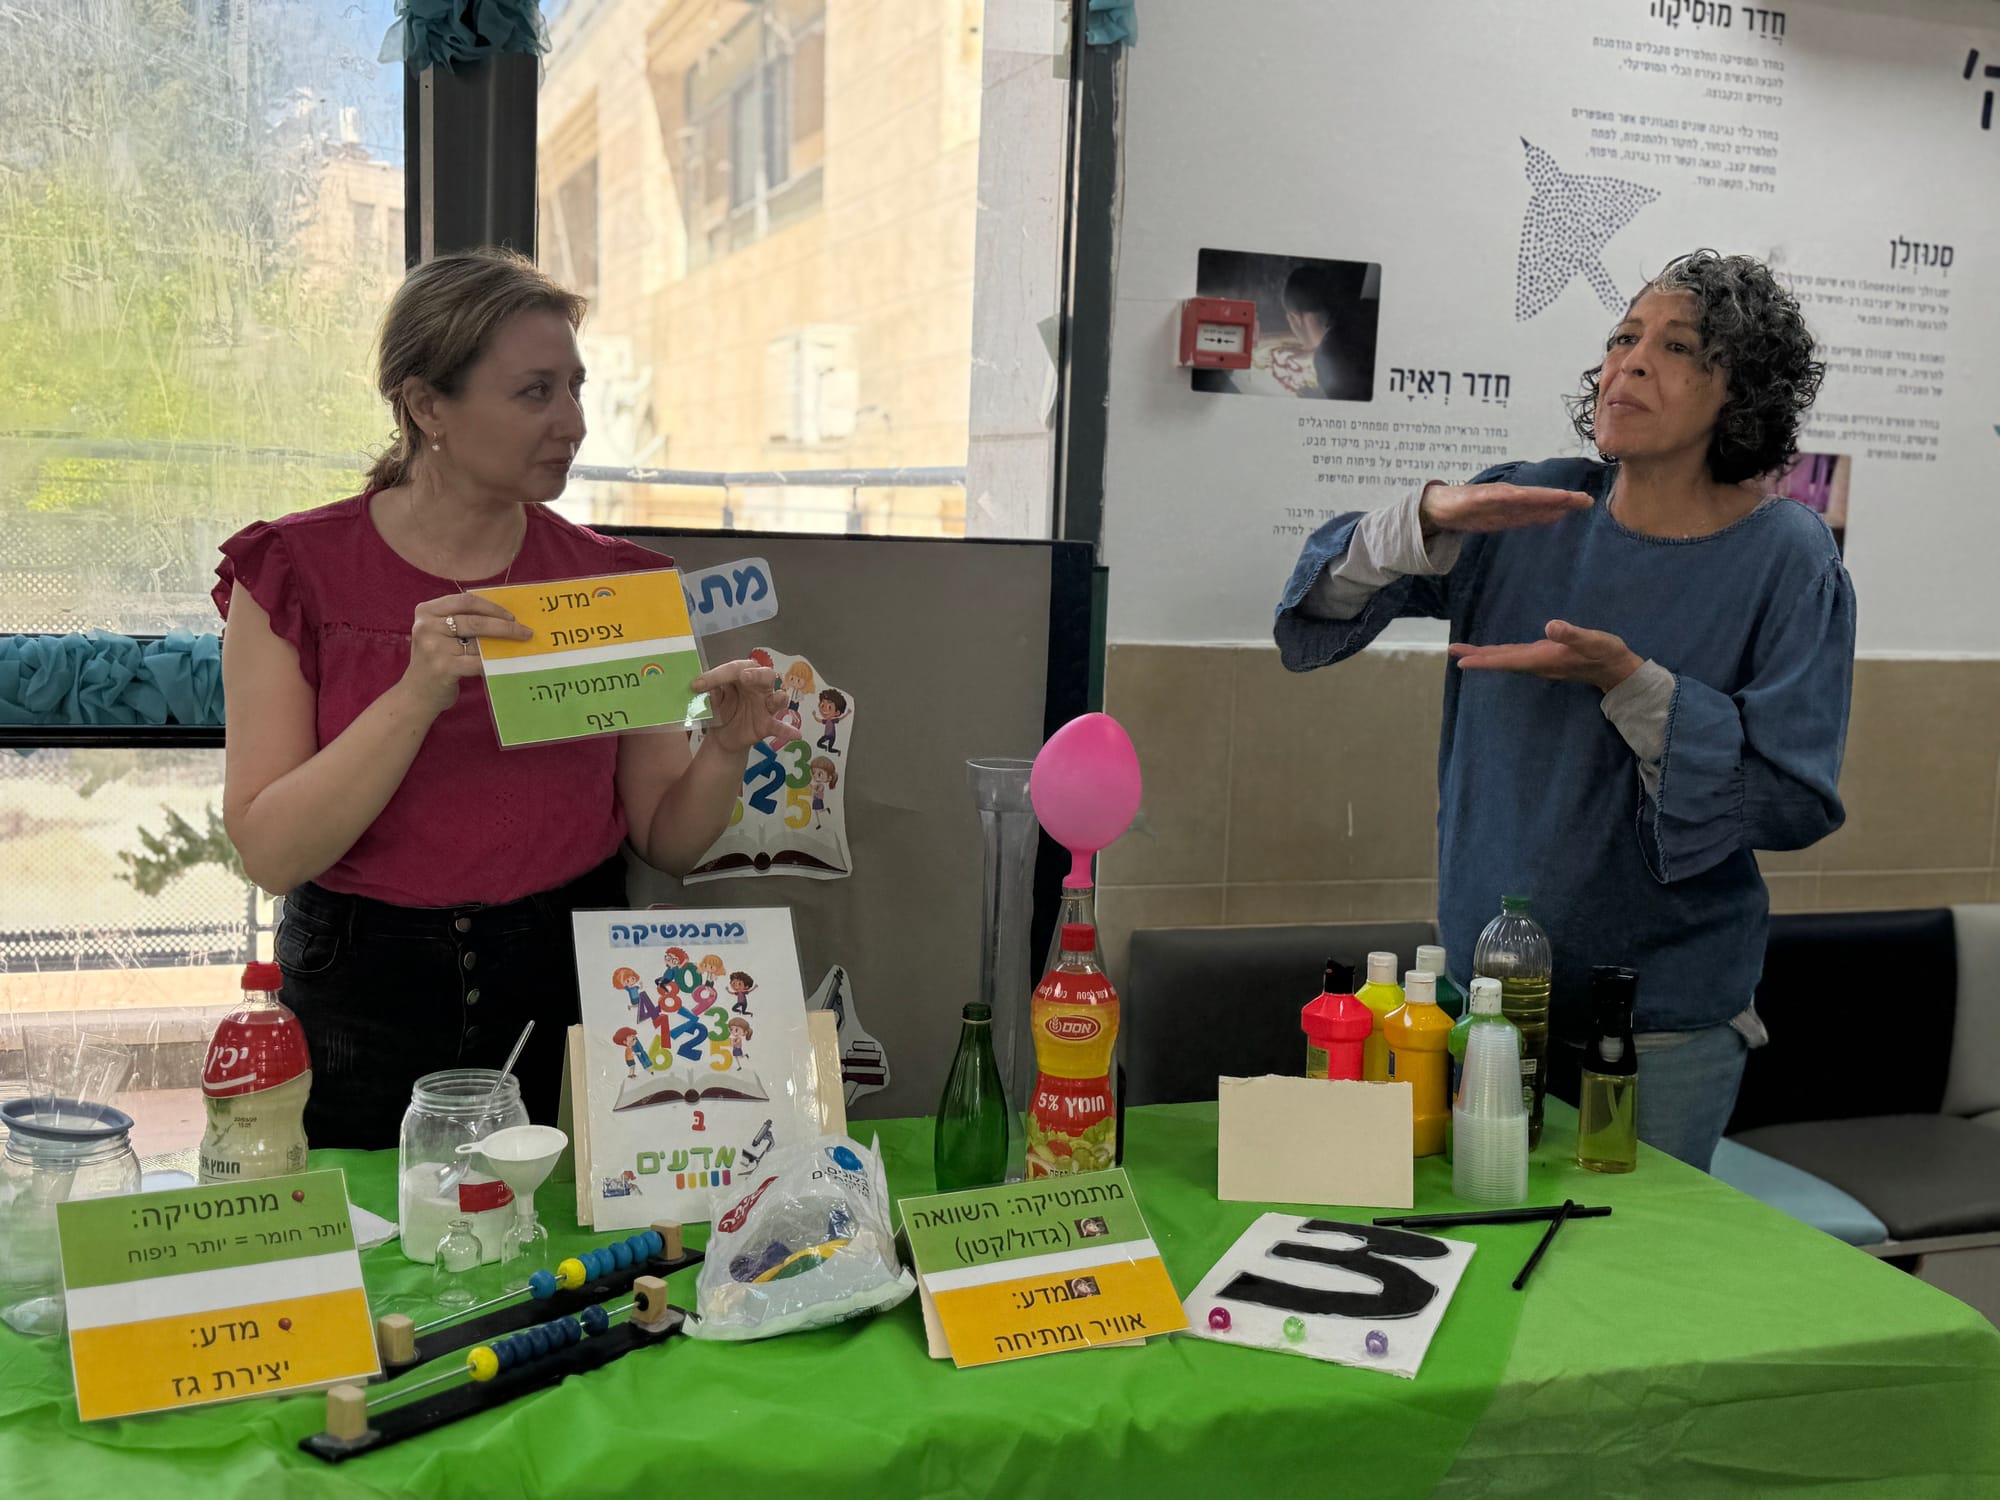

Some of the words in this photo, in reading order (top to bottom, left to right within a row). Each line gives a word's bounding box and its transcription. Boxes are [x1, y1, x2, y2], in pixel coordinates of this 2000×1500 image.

[1298, 416, 1346, 429] ומתרגלים
[1351, 421, 1389, 432] מפתחים
[1393, 422, 1441, 434] התלמידים
[1445, 425, 1479, 436] הראייה
[1484, 427, 1508, 438] בחדר
[1302, 437, 1326, 447] מבט,
[1331, 437, 1359, 448] מיקוד
[1364, 440, 1390, 450] בניהן
[1394, 441, 1426, 452] שונות,
[1429, 442, 1457, 453] ראייה
[1461, 444, 1507, 455] מיומנויות
[1313, 455, 1342, 464] חושים
[1346, 456, 1376, 467] פיתוח
[1380, 456, 1392, 468] על
[1396, 459, 1434, 470] ועובדים
[1437, 461, 1472, 472] וסריקה
[1358, 475, 1380, 484] וחוש
[1384, 476, 1420, 487] השמיעה
[1286, 508, 1314, 518] חיבור
[1273, 524, 1304, 536] למידה
[540, 591, 591, 613] מדע:
[550, 622, 624, 647] צפיפות
[529, 671, 641, 703] מתמטיקה:
[587, 710, 629, 731] רצף
[784, 739, 812, 789] 3
[749, 760, 786, 815] 2
[784, 787, 812, 829] 5
[611, 922, 744, 945] מתמטיקה
[637, 991, 661, 1024] 4
[657, 982, 682, 1013] 8
[691, 985, 718, 1016] 9
[653, 1014, 671, 1049] 1
[670, 1006, 699, 1040] 7
[704, 1007, 729, 1041] 3
[1062, 1022, 1092, 1034] אסם
[677, 1022, 708, 1061] 2
[650, 1034, 673, 1071] 6
[710, 1038, 733, 1072] 5
[1038, 1092, 1059, 1111] 5%
[1064, 1095, 1105, 1118] חומץ
[210, 1158, 241, 1175] חומץ
[637, 1145, 736, 1175] מדעים
[1008, 1182, 1124, 1217] מתמטיקה:
[132, 1192, 280, 1231] מתמטיקה:
[913, 1201, 999, 1230] השוואה
[255, 1228, 302, 1246] חומר
[308, 1221, 347, 1240] יותר
[187, 1238, 227, 1255] יותר
[955, 1221, 1071, 1264] (גדול/קטן)
[128, 1243, 177, 1264] ניפוח
[1012, 1284, 1069, 1310] מדע:
[191, 1320, 260, 1349] מדע:
[1090, 1312, 1147, 1336] אוויר
[994, 1323, 1084, 1354] ומתיחה
[173, 1375, 201, 1398] גז
[214, 1361, 289, 1391] יצירת
